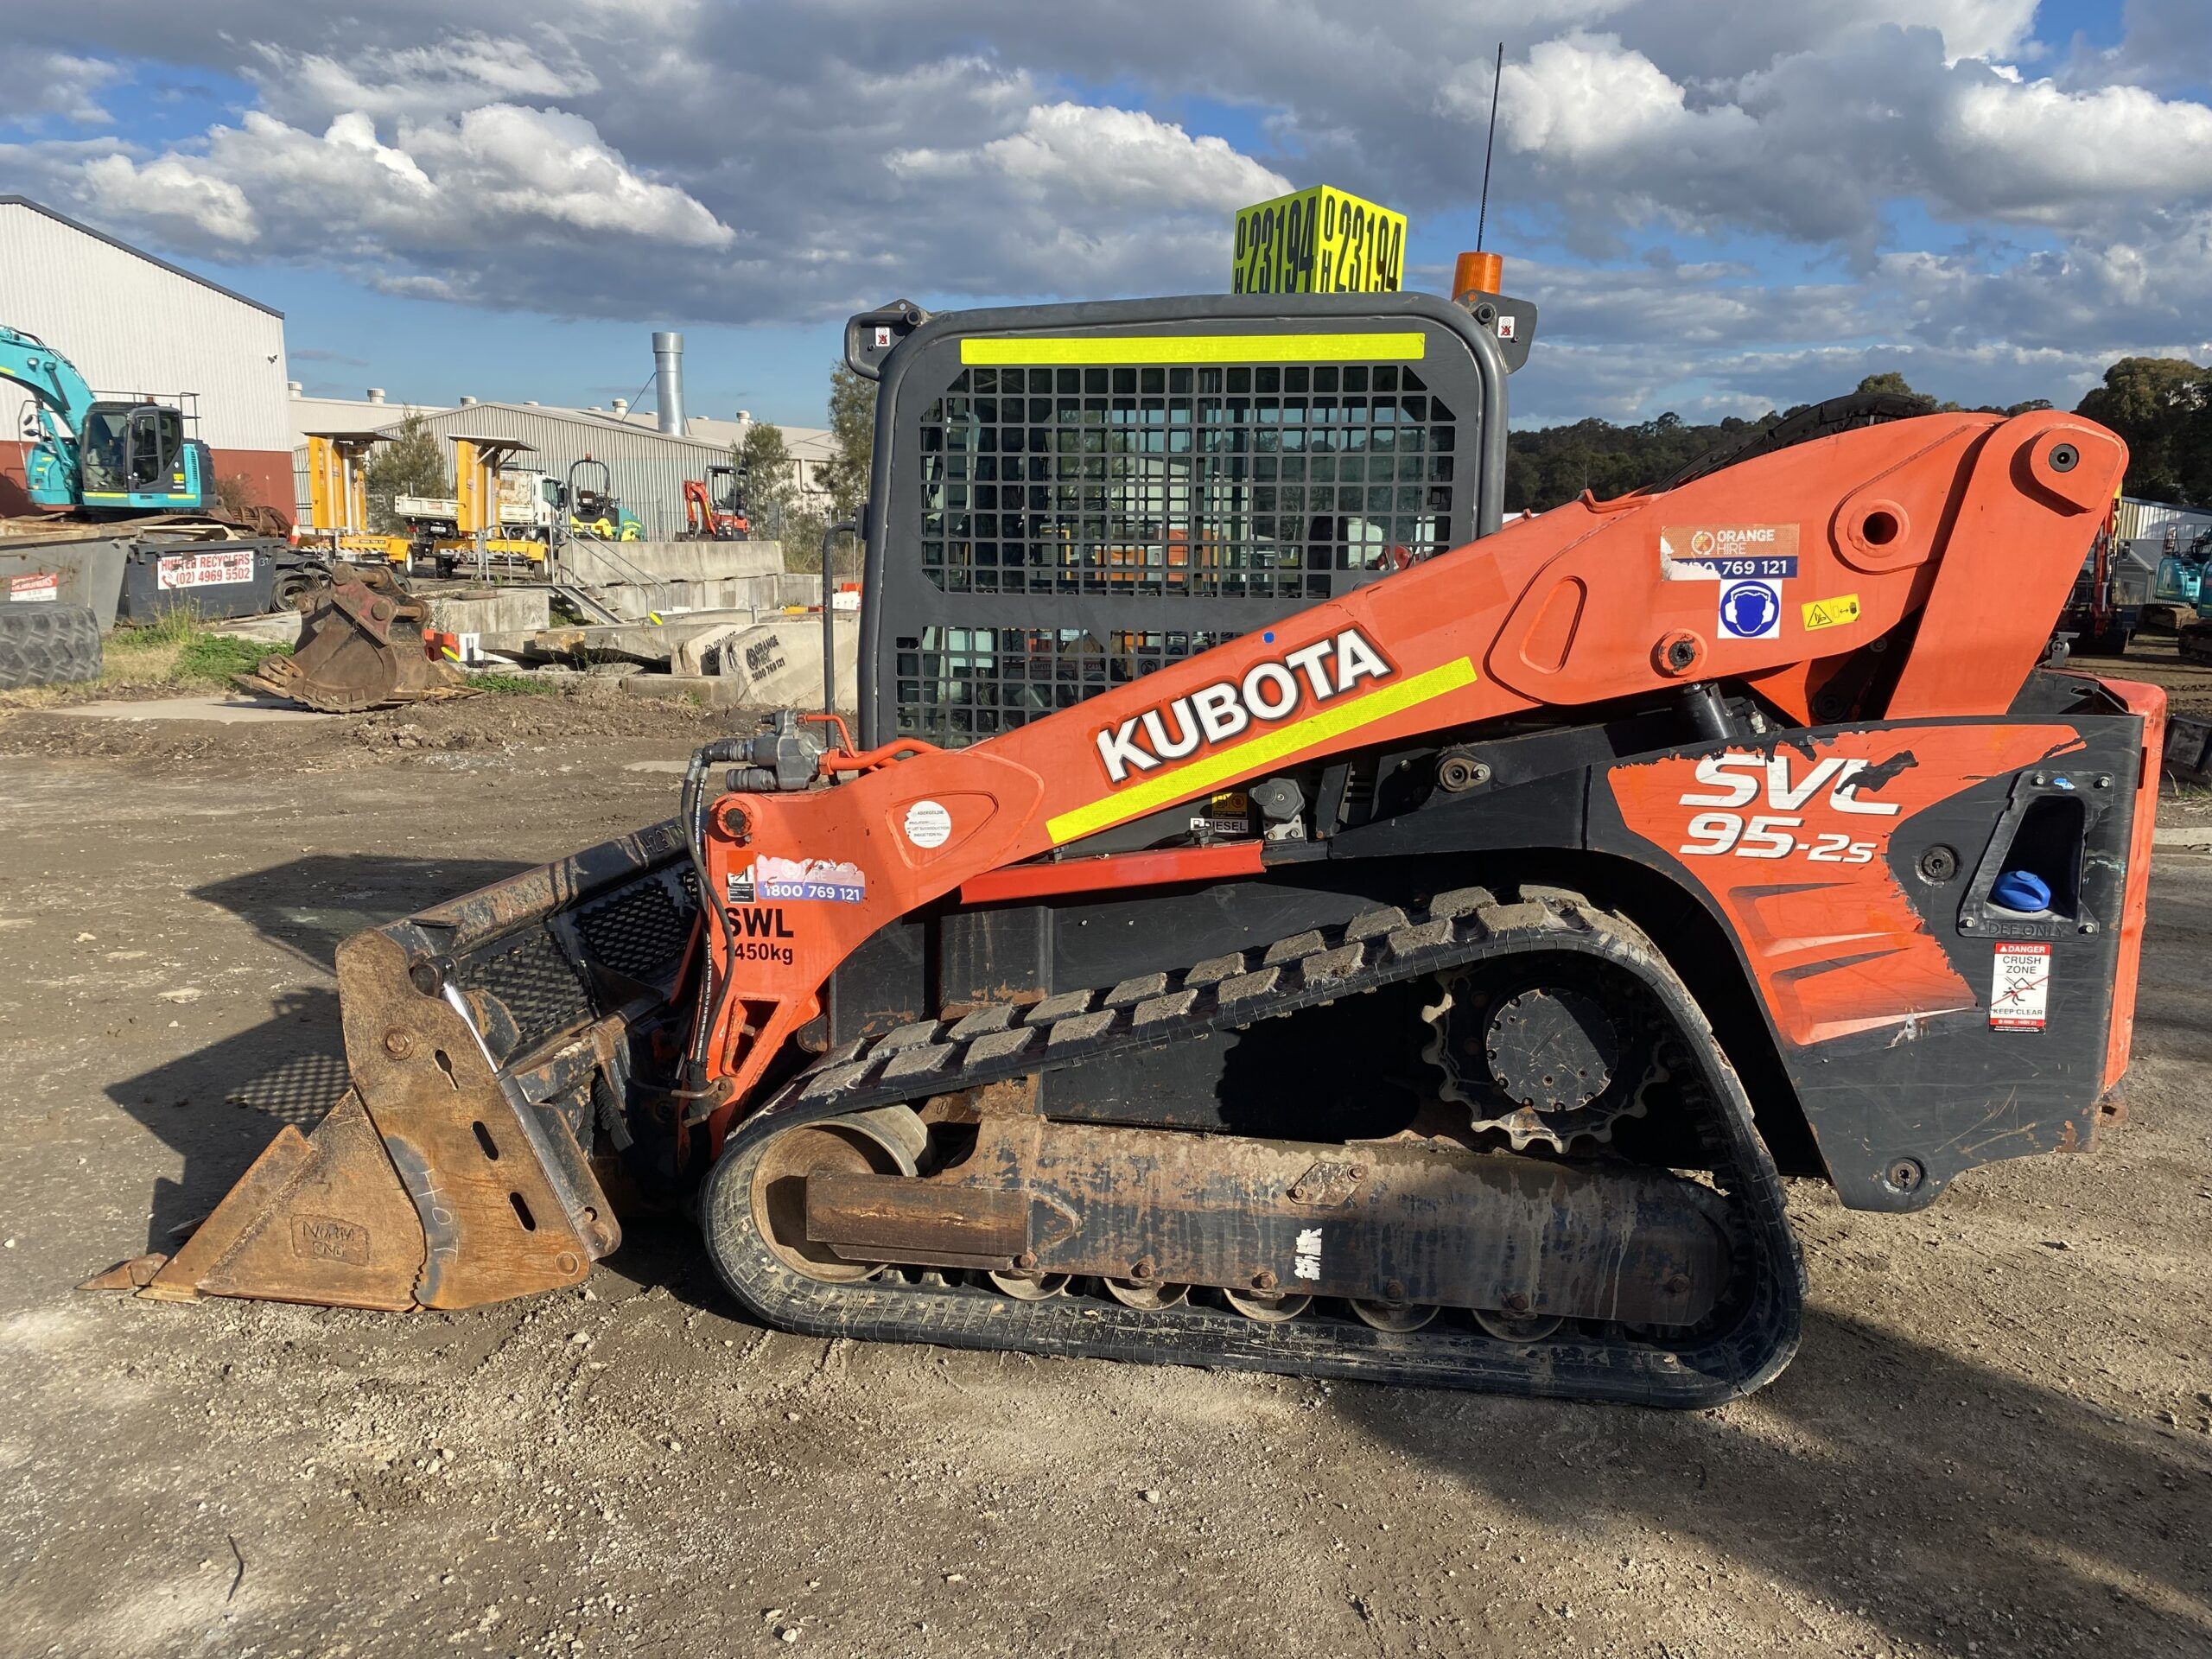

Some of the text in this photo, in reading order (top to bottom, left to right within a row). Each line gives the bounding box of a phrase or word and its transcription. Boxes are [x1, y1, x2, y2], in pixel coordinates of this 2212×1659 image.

[1247, 196, 1316, 293] 23194
[1335, 200, 1402, 292] 23194
[1717, 529, 1775, 543] ORANGE
[1717, 542, 1746, 555] HIRE
[176, 567, 249, 585] (02) 4969 5502
[1722, 561, 1755, 575] 769
[1761, 560, 1787, 575] 121
[754, 634, 779, 655] ORANGE
[1096, 628, 1392, 783] KUBOTA
[765, 884, 803, 898] 1800
[808, 885, 836, 899] 769
[839, 887, 860, 901] 121
[722, 907, 794, 938] SWL
[1988, 923, 2066, 938] DEF ONLY
[2003, 956, 2041, 964] CRUSH
[2006, 965, 2037, 974] ZONE
